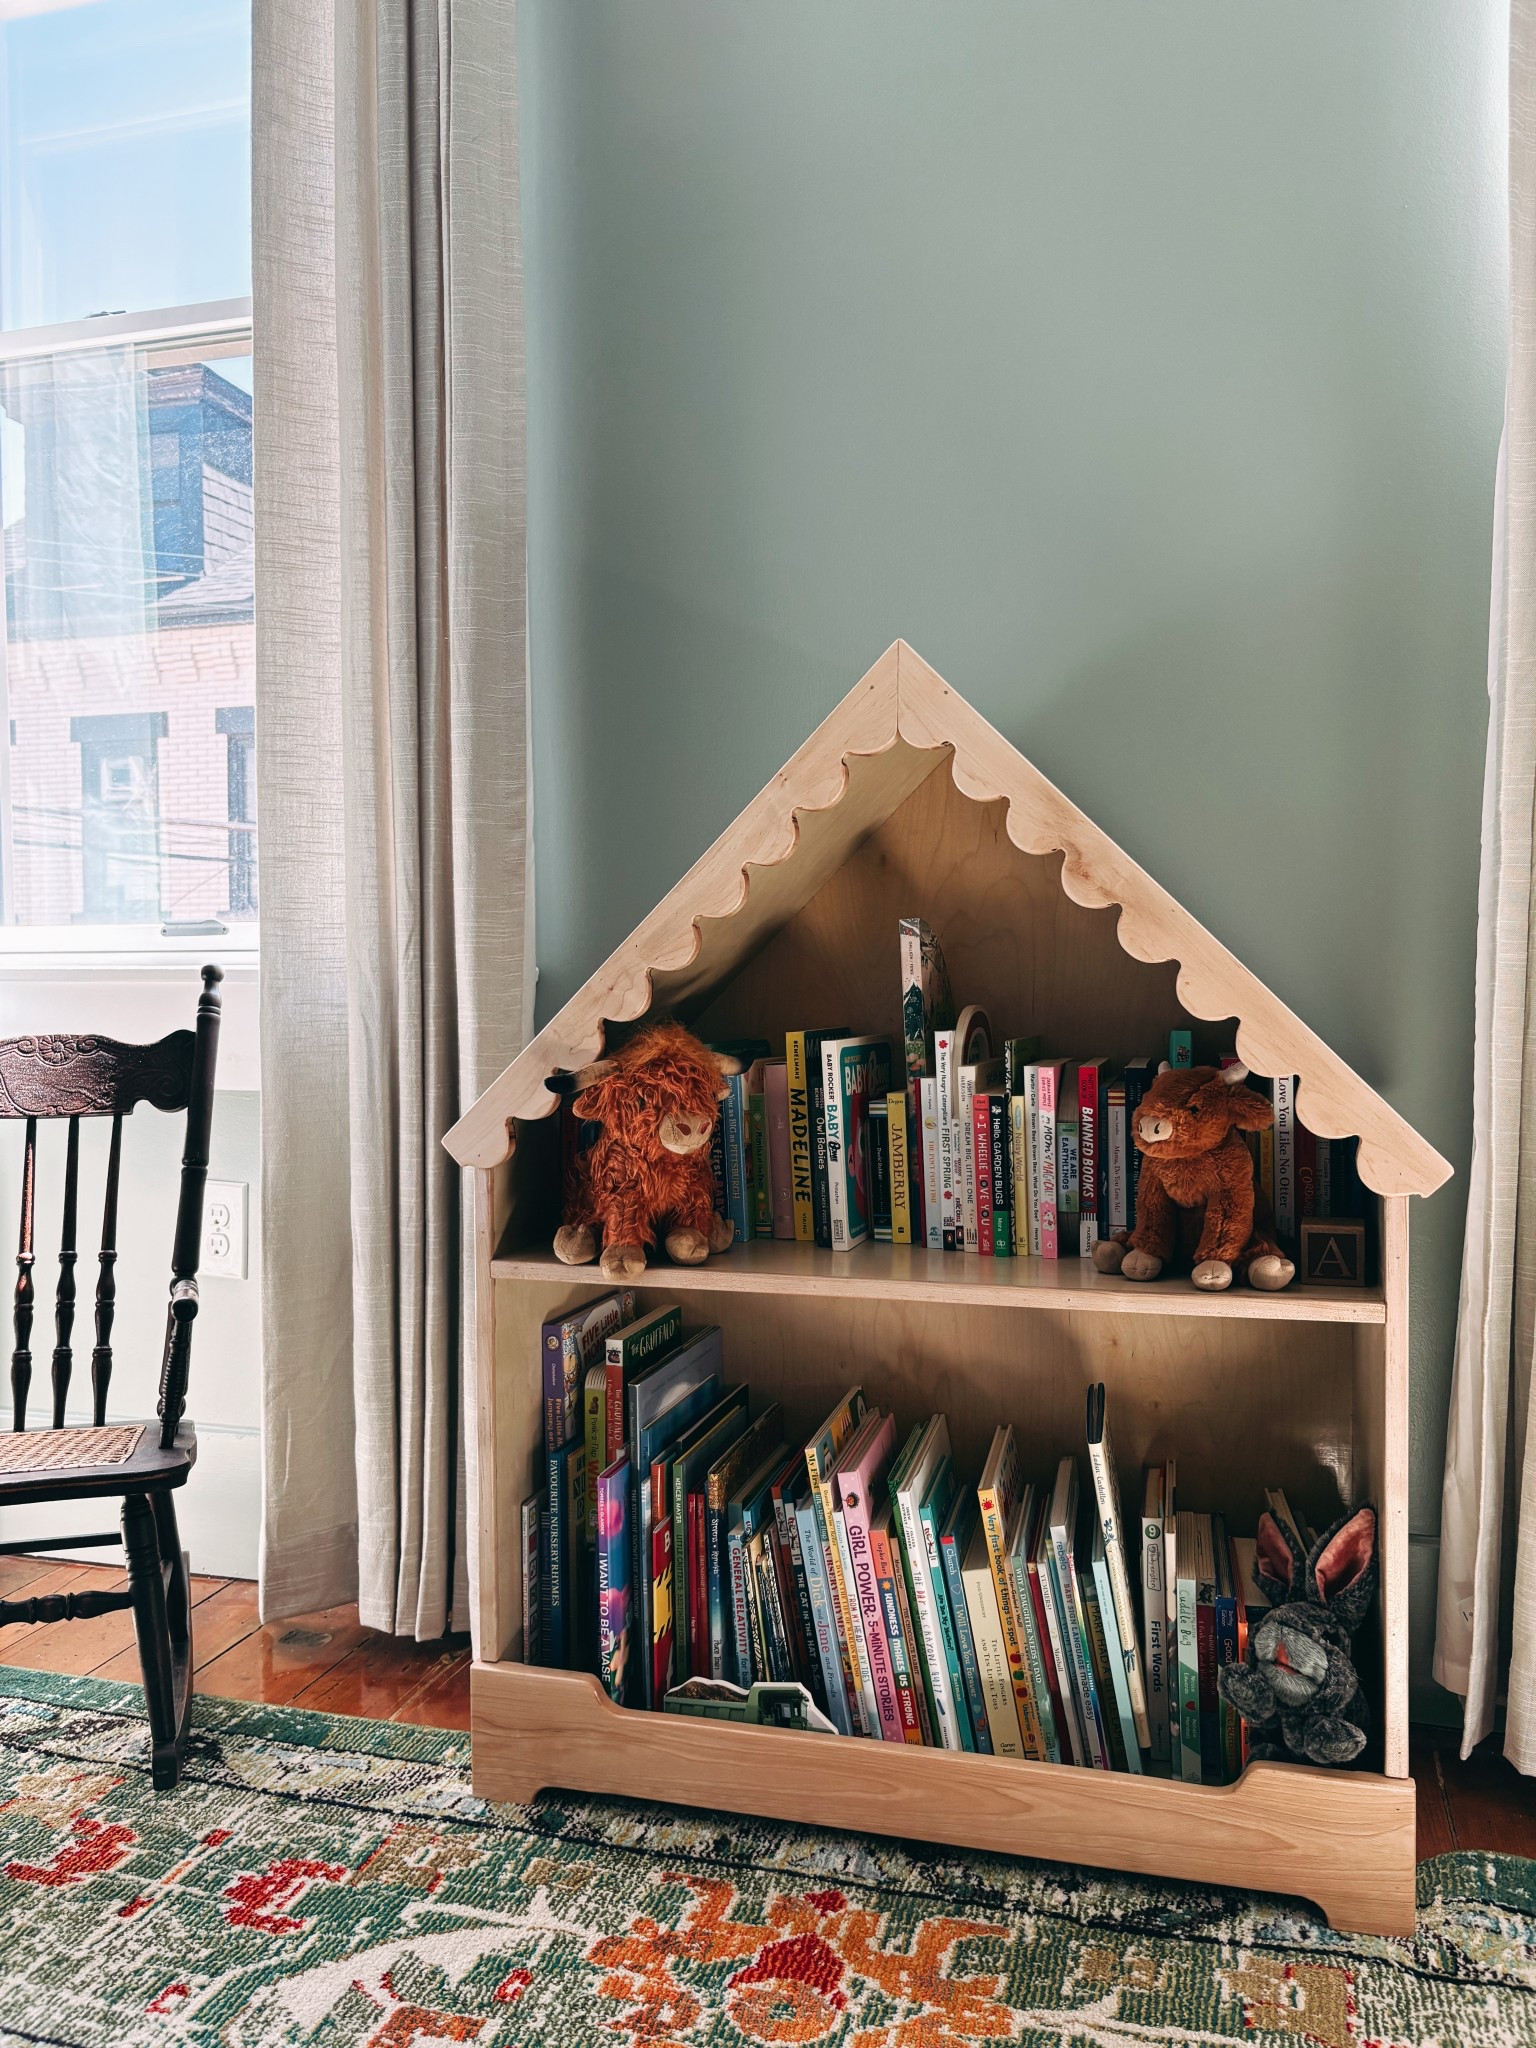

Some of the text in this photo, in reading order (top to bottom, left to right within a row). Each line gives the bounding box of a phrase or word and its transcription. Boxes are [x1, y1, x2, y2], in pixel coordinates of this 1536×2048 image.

[845, 1064, 867, 1096] BABY
[1278, 1077, 1289, 1103] Love
[827, 1104, 839, 1139] BABY
[1082, 1106, 1094, 1156] BANNED
[1279, 1107, 1289, 1127] You
[790, 1088, 810, 1203] MADELINE
[816, 1117, 827, 1170] Owl Babies
[941, 1128, 951, 1154] FIRST
[978, 1133, 989, 1170] WHEELIE
[1013, 1132, 1024, 1181] Noisy World
[1070, 1148, 1077, 1161] WE
[1279, 1131, 1290, 1155] Like
[892, 1124, 906, 1210] JAMBERRY
[942, 1156, 951, 1189] SPRING
[965, 1164, 973, 1186] LITTLE
[993, 1141, 1002, 1178] GARDEN
[1061, 1137, 1069, 1190] EARTHLINGS
[1280, 1158, 1290, 1174] No
[979, 1174, 989, 1200] LOVE
[994, 1180, 1004, 1205] BUGS
[1082, 1158, 1095, 1198] BOOKS
[1279, 1177, 1290, 1208] Otter
[1299, 1166, 1313, 1216] CORDURO
[981, 1204, 990, 1226] YOU
[1311, 1236, 1353, 1277] A
[582, 1309, 619, 1351] FIVE Little
[807, 1453, 816, 1466] My
[550, 1460, 559, 1514] FAVOURITE
[588, 1460, 600, 1501] WHO
[811, 1468, 821, 1489] First
[550, 1516, 558, 1562] NURSERY
[711, 1519, 720, 1542] Stevens
[804, 1530, 812, 1543] The
[807, 1545, 815, 1565] World
[824, 1545, 838, 1591] NURSERY
[946, 1548, 956, 1575] Church
[1056, 1541, 1067, 1571] rebelo
[551, 1564, 560, 1606] RHYMES
[599, 1558, 609, 1597] WANT
[810, 1567, 818, 1575] of
[914, 1571, 923, 1586] THE
[987, 1513, 1018, 1646] Very first book of things to spot
[809, 1576, 825, 1608] Dick
[856, 1563, 877, 1618] POWER:
[916, 1590, 927, 1606] DAY
[937, 1594, 945, 1604] Are
[1040, 1574, 1052, 1610] YUMMERS!
[600, 1600, 609, 1616] TO
[732, 1547, 751, 1689] GENERAL RELATIVITY for babi
[797, 1572, 817, 1658] THE CAT IN THE HAT
[833, 1594, 845, 1637] RHYMES
[920, 1610, 929, 1620] the
[940, 1616, 948, 1626] My
[956, 1610, 966, 1627] Will
[1091, 1605, 1105, 1635] MARY
[1179, 1590, 1191, 1646] Cuddle Bug
[600, 1619, 609, 1636] BE
[817, 1621, 831, 1653] Jane
[943, 1627, 954, 1651] Mother?
[959, 1629, 968, 1649] Love
[1015, 1567, 1024, 1583] WHY
[1020, 1594, 1032, 1634] DAUGHTER
[1027, 1636, 1037, 1659] NEEDS
[1034, 1668, 1042, 1684] DAD
[600, 1637, 610, 1646] A
[905, 1619, 915, 1654] CHOCOLATE
[911, 1655, 919, 1675] RABBIT
[922, 1624, 937, 1667] CRAYONS
[1064, 1583, 1095, 1721] BABY SIGN LANGUAGE made easy
[1097, 1638, 1110, 1664] HAD
[1151, 1621, 1163, 1693] First Words
[1223, 1638, 1233, 1663] Good
[601, 1650, 611, 1682] VASE
[825, 1656, 833, 1670] and
[884, 1592, 915, 1725] KINDNESS MAKES US STRONG
[963, 1650, 972, 1665] You
[1054, 1648, 1064, 1672] Marshall
[1103, 1666, 1111, 1674] A
[827, 1672, 838, 1698] Friends
[932, 1671, 943, 1694] QUIT
[952, 1673, 961, 1702] Eastman
[966, 1667, 977, 1698] Forever
[994, 1654, 1002, 1677] LITTLE
[998, 1678, 1008, 1706] FINGERS
[1104, 1677, 1118, 1716] LITTLE
[1112, 1717, 1124, 1747] LAMB
